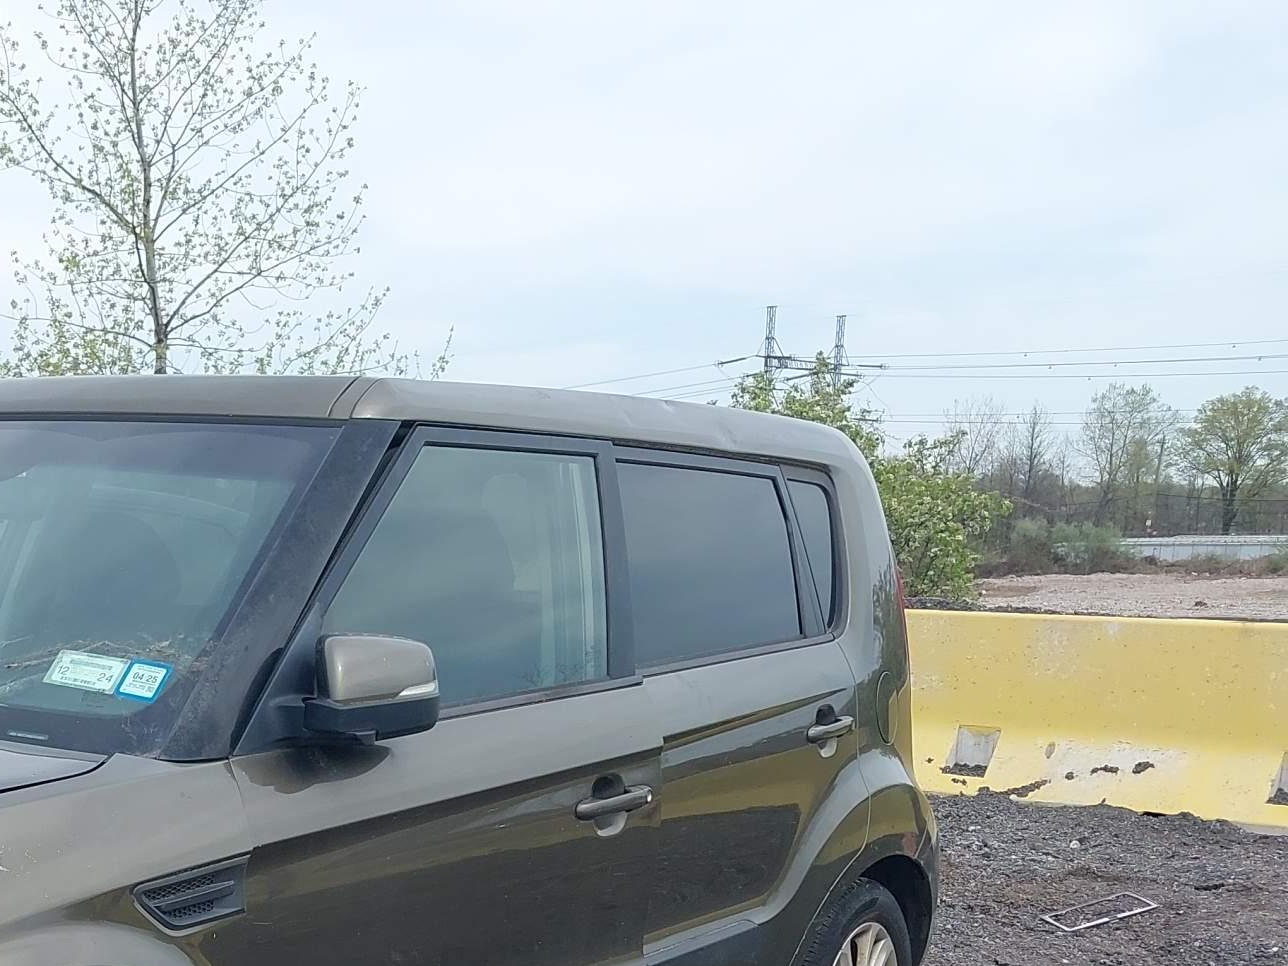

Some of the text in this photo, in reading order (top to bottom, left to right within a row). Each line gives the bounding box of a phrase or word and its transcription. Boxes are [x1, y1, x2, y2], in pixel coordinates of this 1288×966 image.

[57, 664, 70, 676] 12
[96, 672, 114, 683] 24
[132, 671, 159, 684] 04 25
